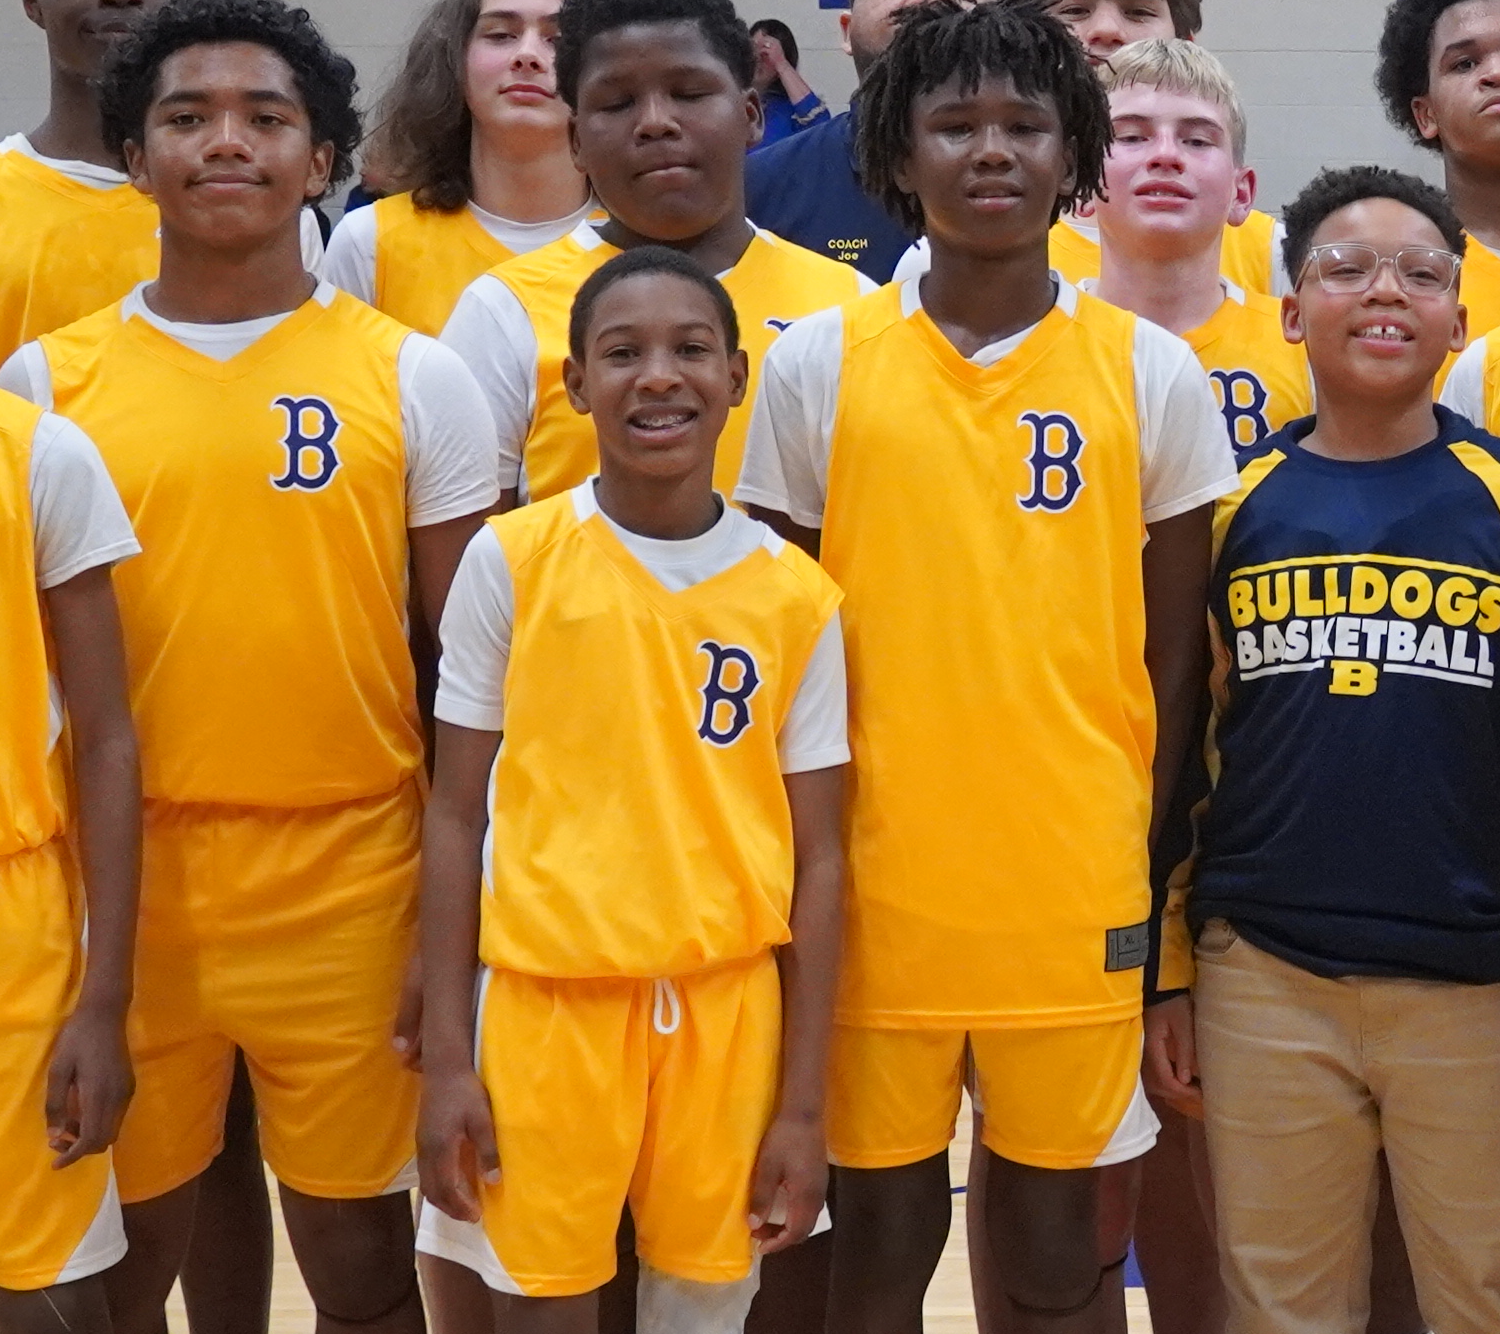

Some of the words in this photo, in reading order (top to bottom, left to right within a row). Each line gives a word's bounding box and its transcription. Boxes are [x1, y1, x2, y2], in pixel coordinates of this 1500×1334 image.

[827, 238, 868, 249] COACH
[837, 250, 859, 261] Joe
[270, 395, 344, 493] B
[1208, 368, 1276, 454] B
[1016, 409, 1087, 513] B
[1236, 617, 1494, 677] BASKETBALL
[1329, 660, 1378, 696] B
[696, 639, 764, 748] B
